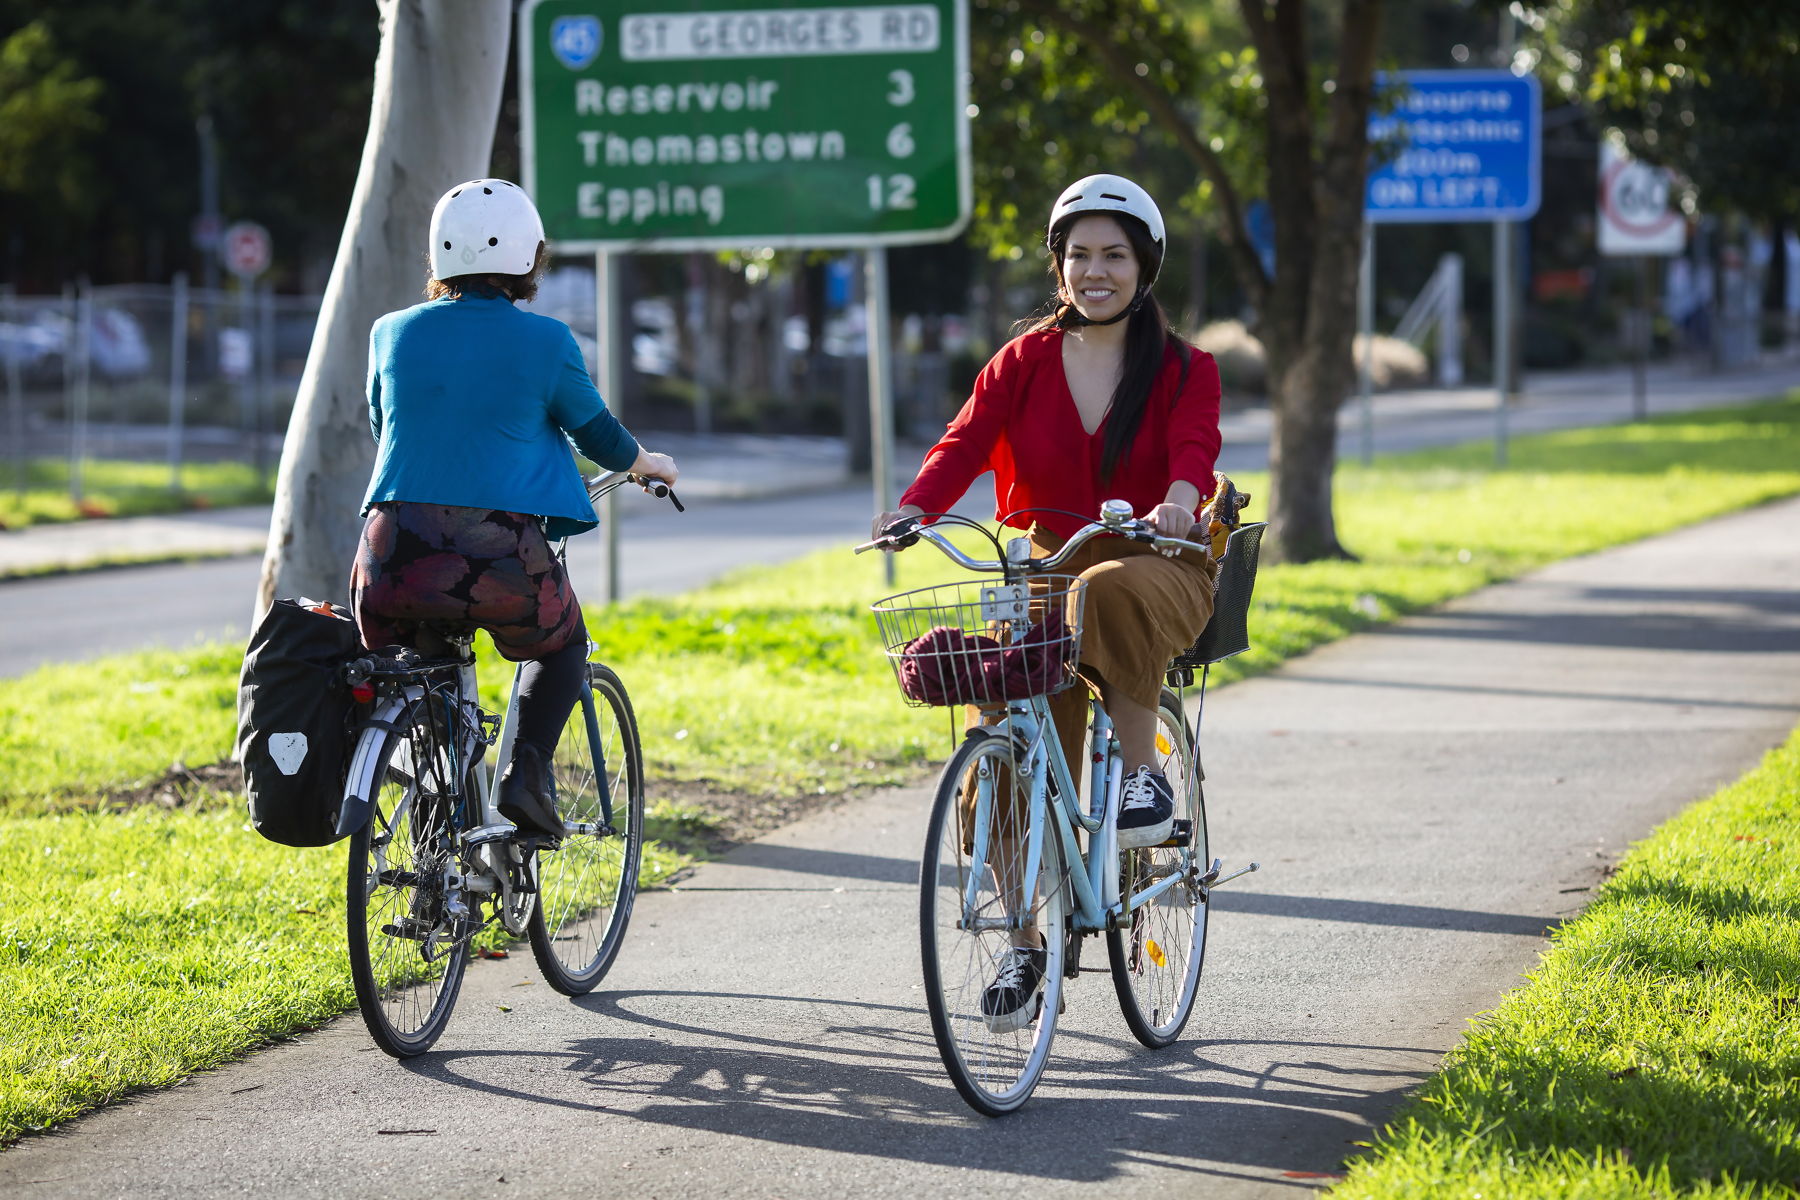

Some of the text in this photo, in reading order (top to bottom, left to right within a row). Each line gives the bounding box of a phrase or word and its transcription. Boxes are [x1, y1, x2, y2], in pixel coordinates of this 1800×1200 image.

[629, 12, 932, 53] ST GEORGES RD
[575, 69, 915, 116] Reservoir 3
[577, 123, 915, 166] Thomastown 6
[577, 173, 917, 226] Epping 12
[1371, 178, 1417, 207] ON
